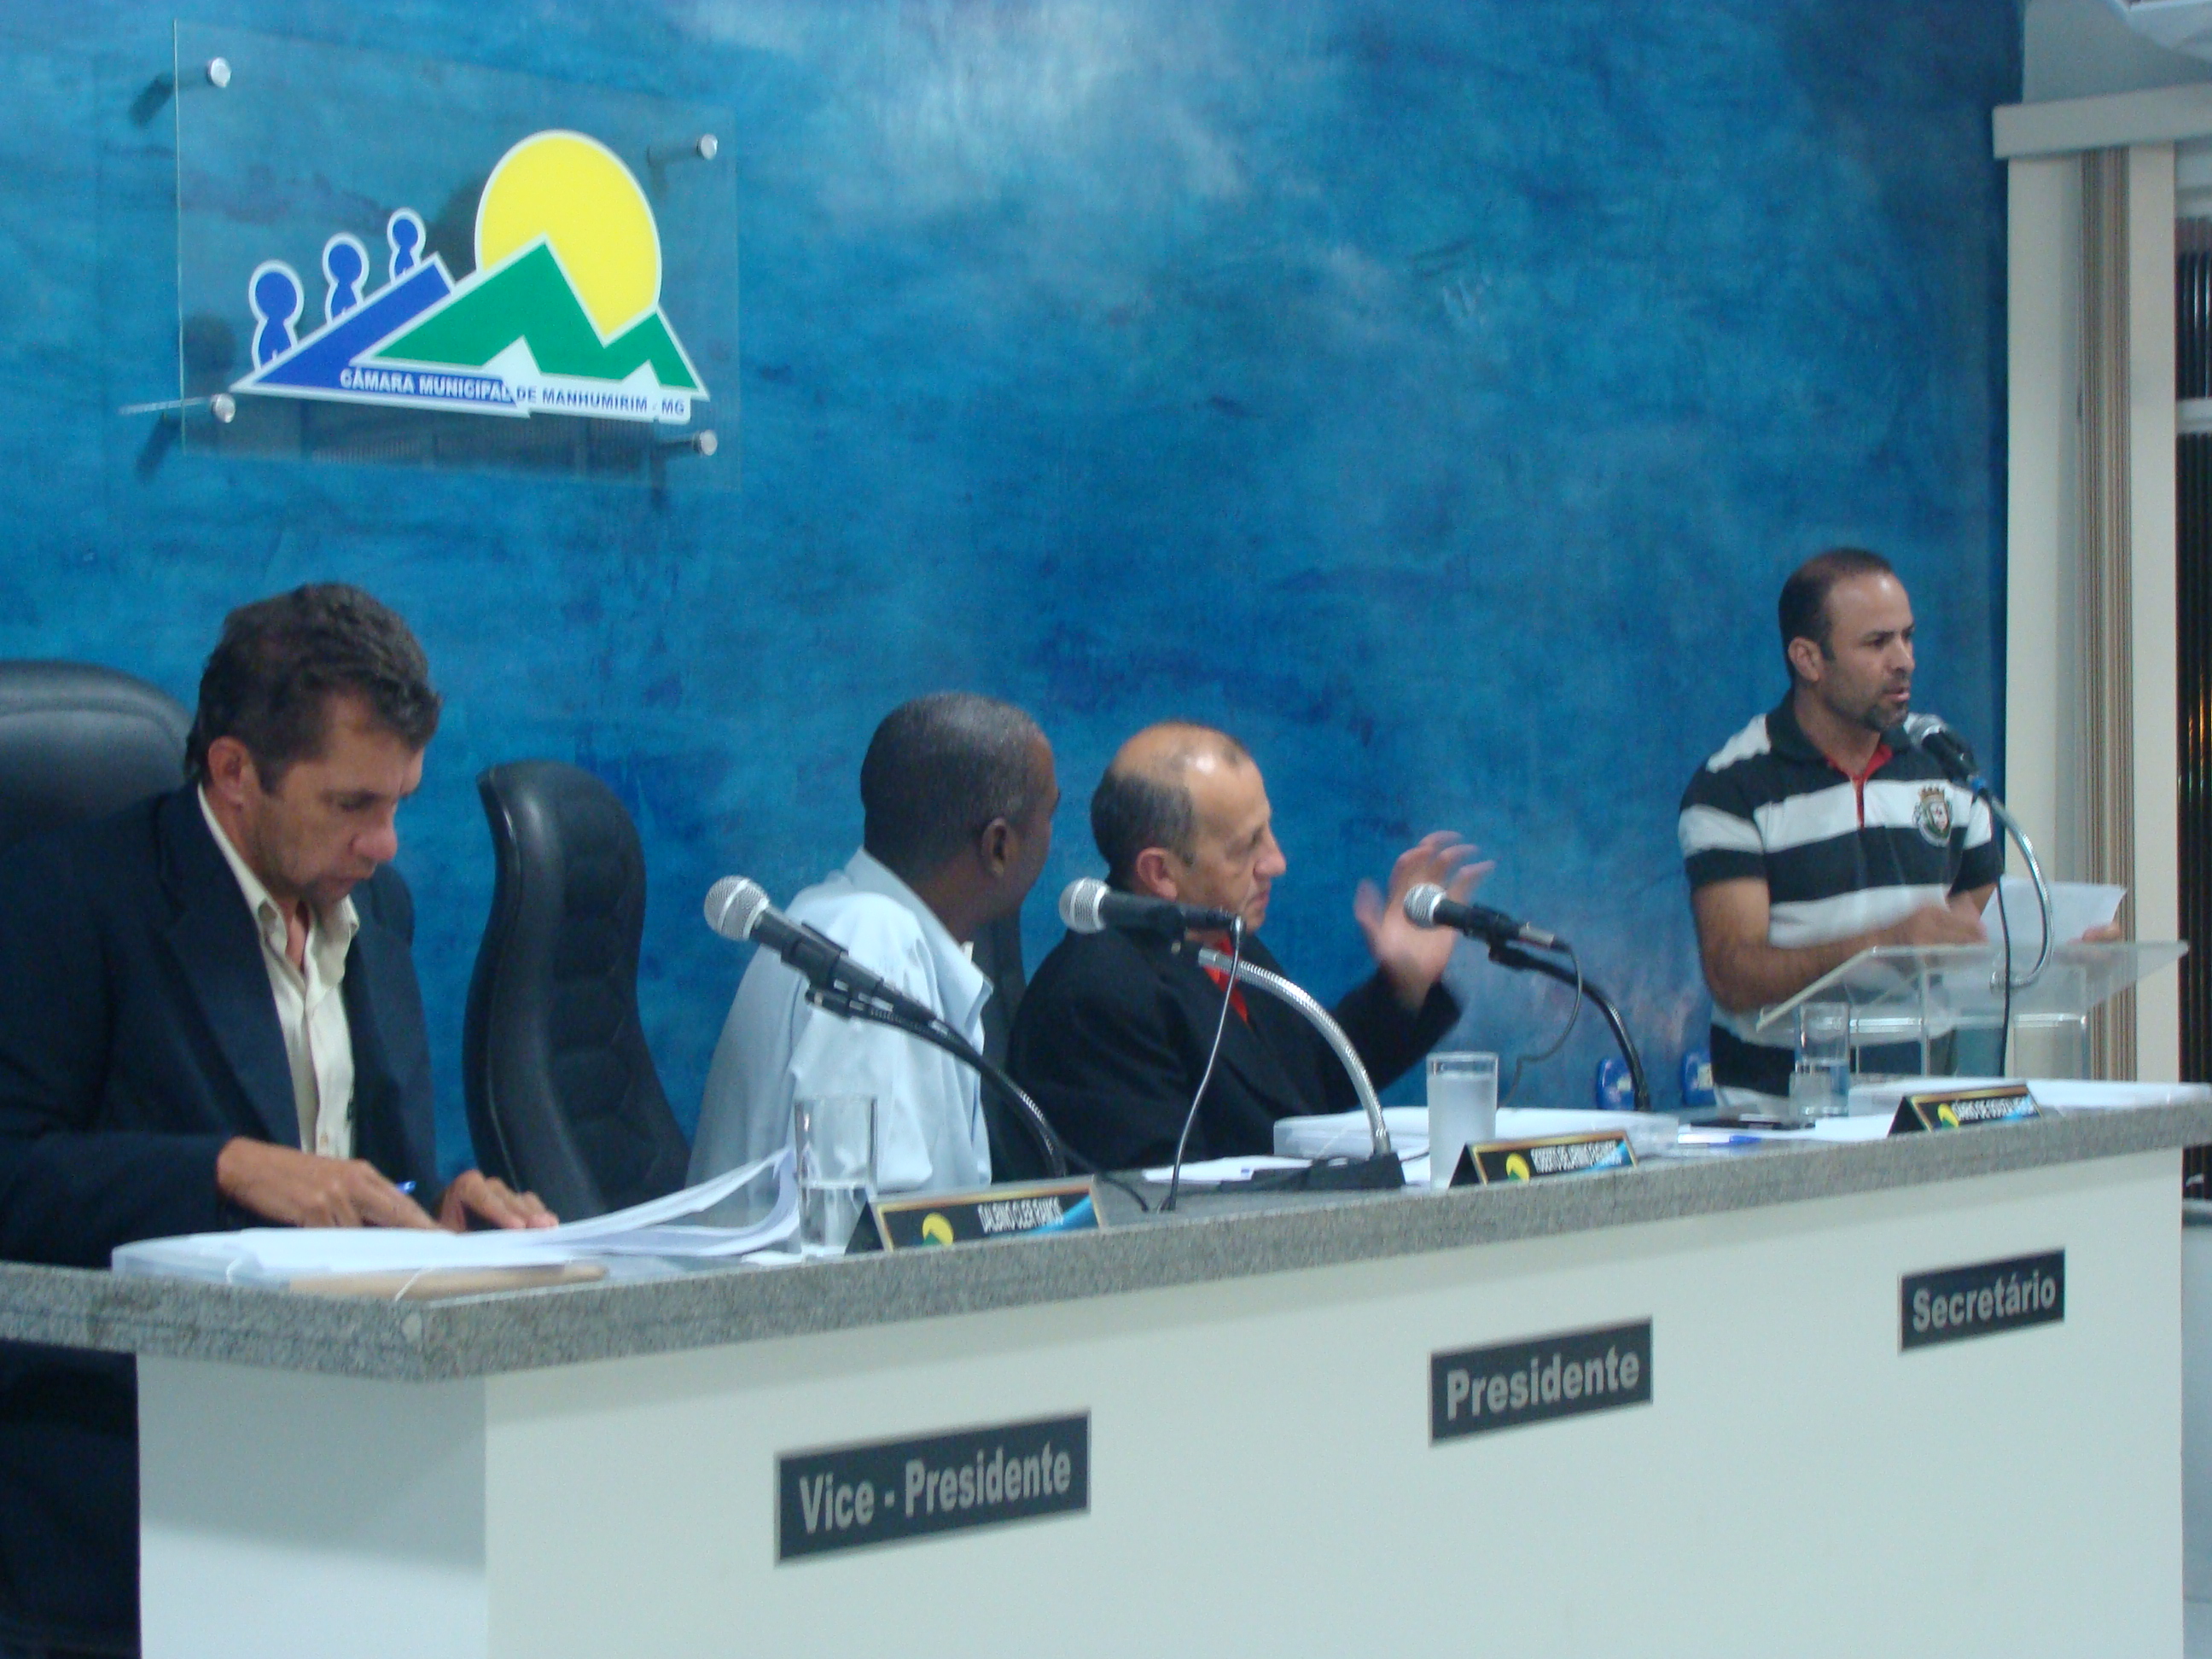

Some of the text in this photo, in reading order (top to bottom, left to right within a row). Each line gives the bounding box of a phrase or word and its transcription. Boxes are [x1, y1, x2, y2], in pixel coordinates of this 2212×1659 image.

[419, 374, 514, 404] MUNICIPAL
[516, 384, 537, 404] DE
[542, 387, 648, 413] MANHUMIRIM
[661, 397, 685, 416] MG
[1912, 1269, 2057, 1333] Secretário
[1447, 1345, 1640, 1421] Presidente
[800, 1471, 875, 1534] Vice
[905, 1441, 1072, 1517] Presidente
